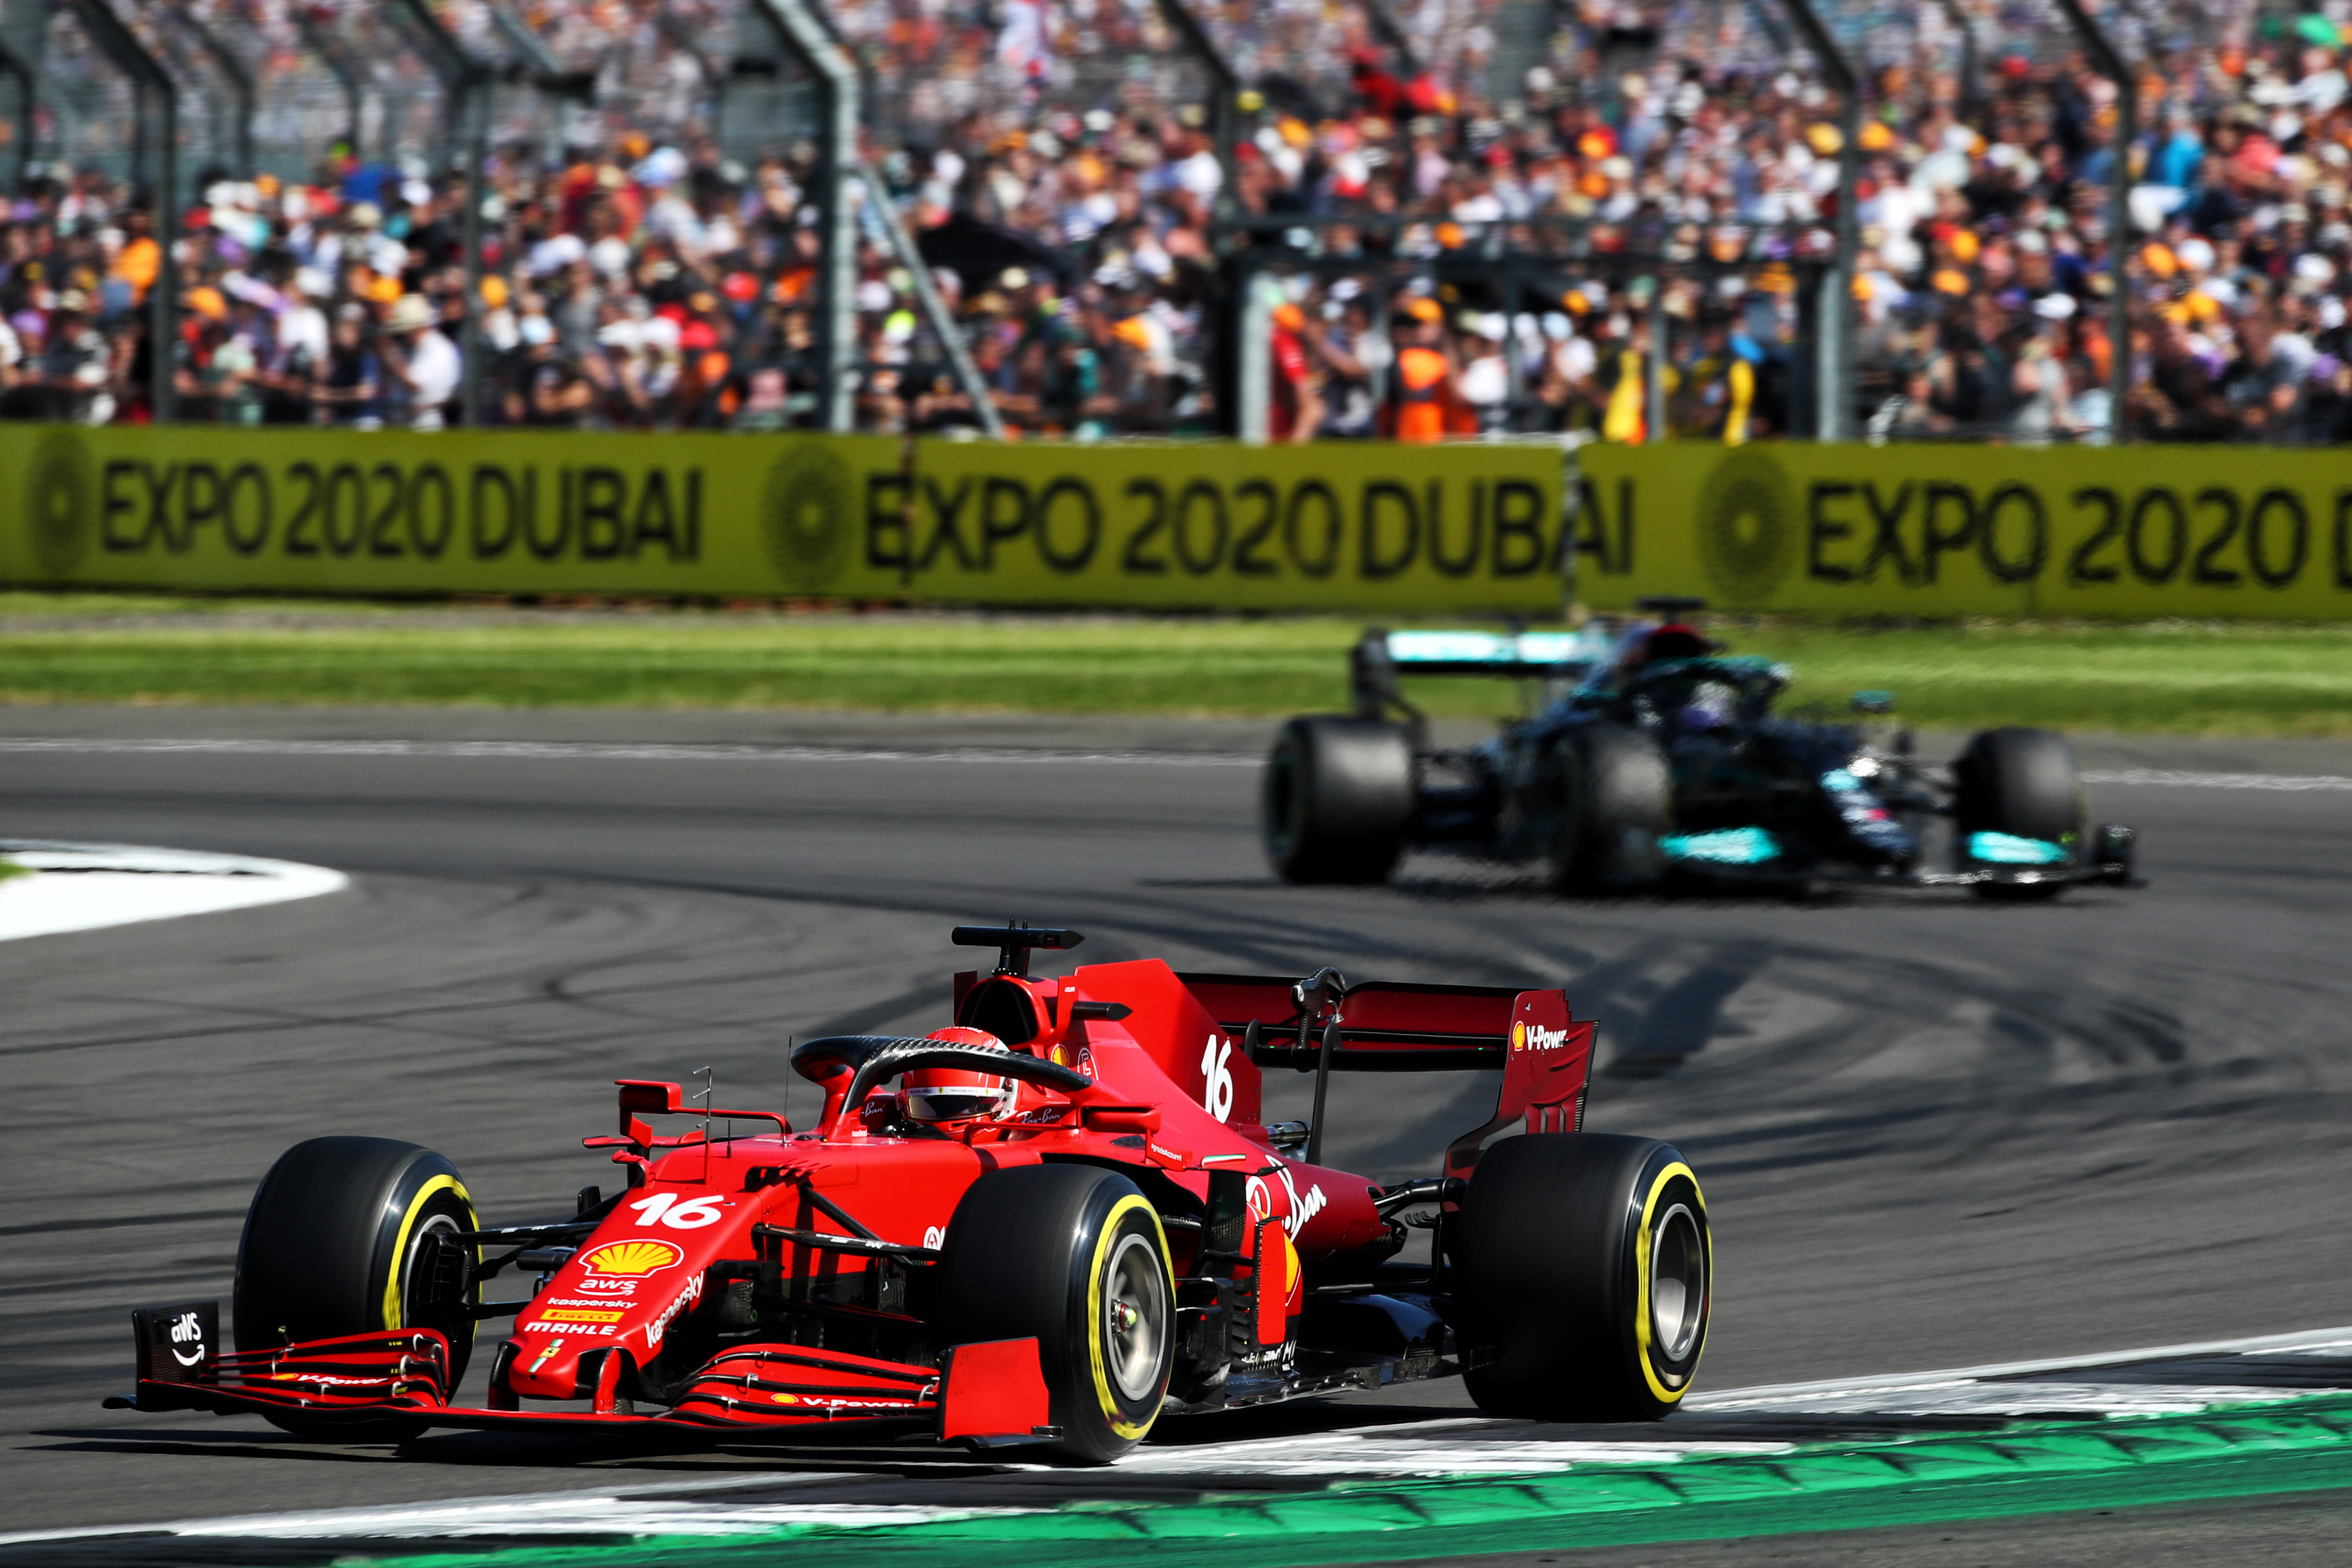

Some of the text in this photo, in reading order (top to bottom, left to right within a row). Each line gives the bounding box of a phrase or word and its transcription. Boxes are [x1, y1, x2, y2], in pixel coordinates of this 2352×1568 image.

[101, 461, 703, 562] EXPO 2020 DUBAI
[867, 475, 1635, 578] EXPO 2020 DUBAI
[1806, 480, 2051, 585] EXPO
[2068, 487, 2309, 591] 2020
[1201, 1034, 1233, 1124] 16
[1016, 1109, 1060, 1124] Ray-Ban
[629, 1193, 724, 1229] 16
[579, 1279, 638, 1289] aws
[547, 1297, 638, 1308] kaspersky
[645, 1270, 704, 1348] kaspersky
[171, 1312, 202, 1343] aws
[524, 1322, 617, 1335] MAHLE
[298, 1375, 389, 1384] V-Power
[802, 1397, 915, 1408] V-Power
